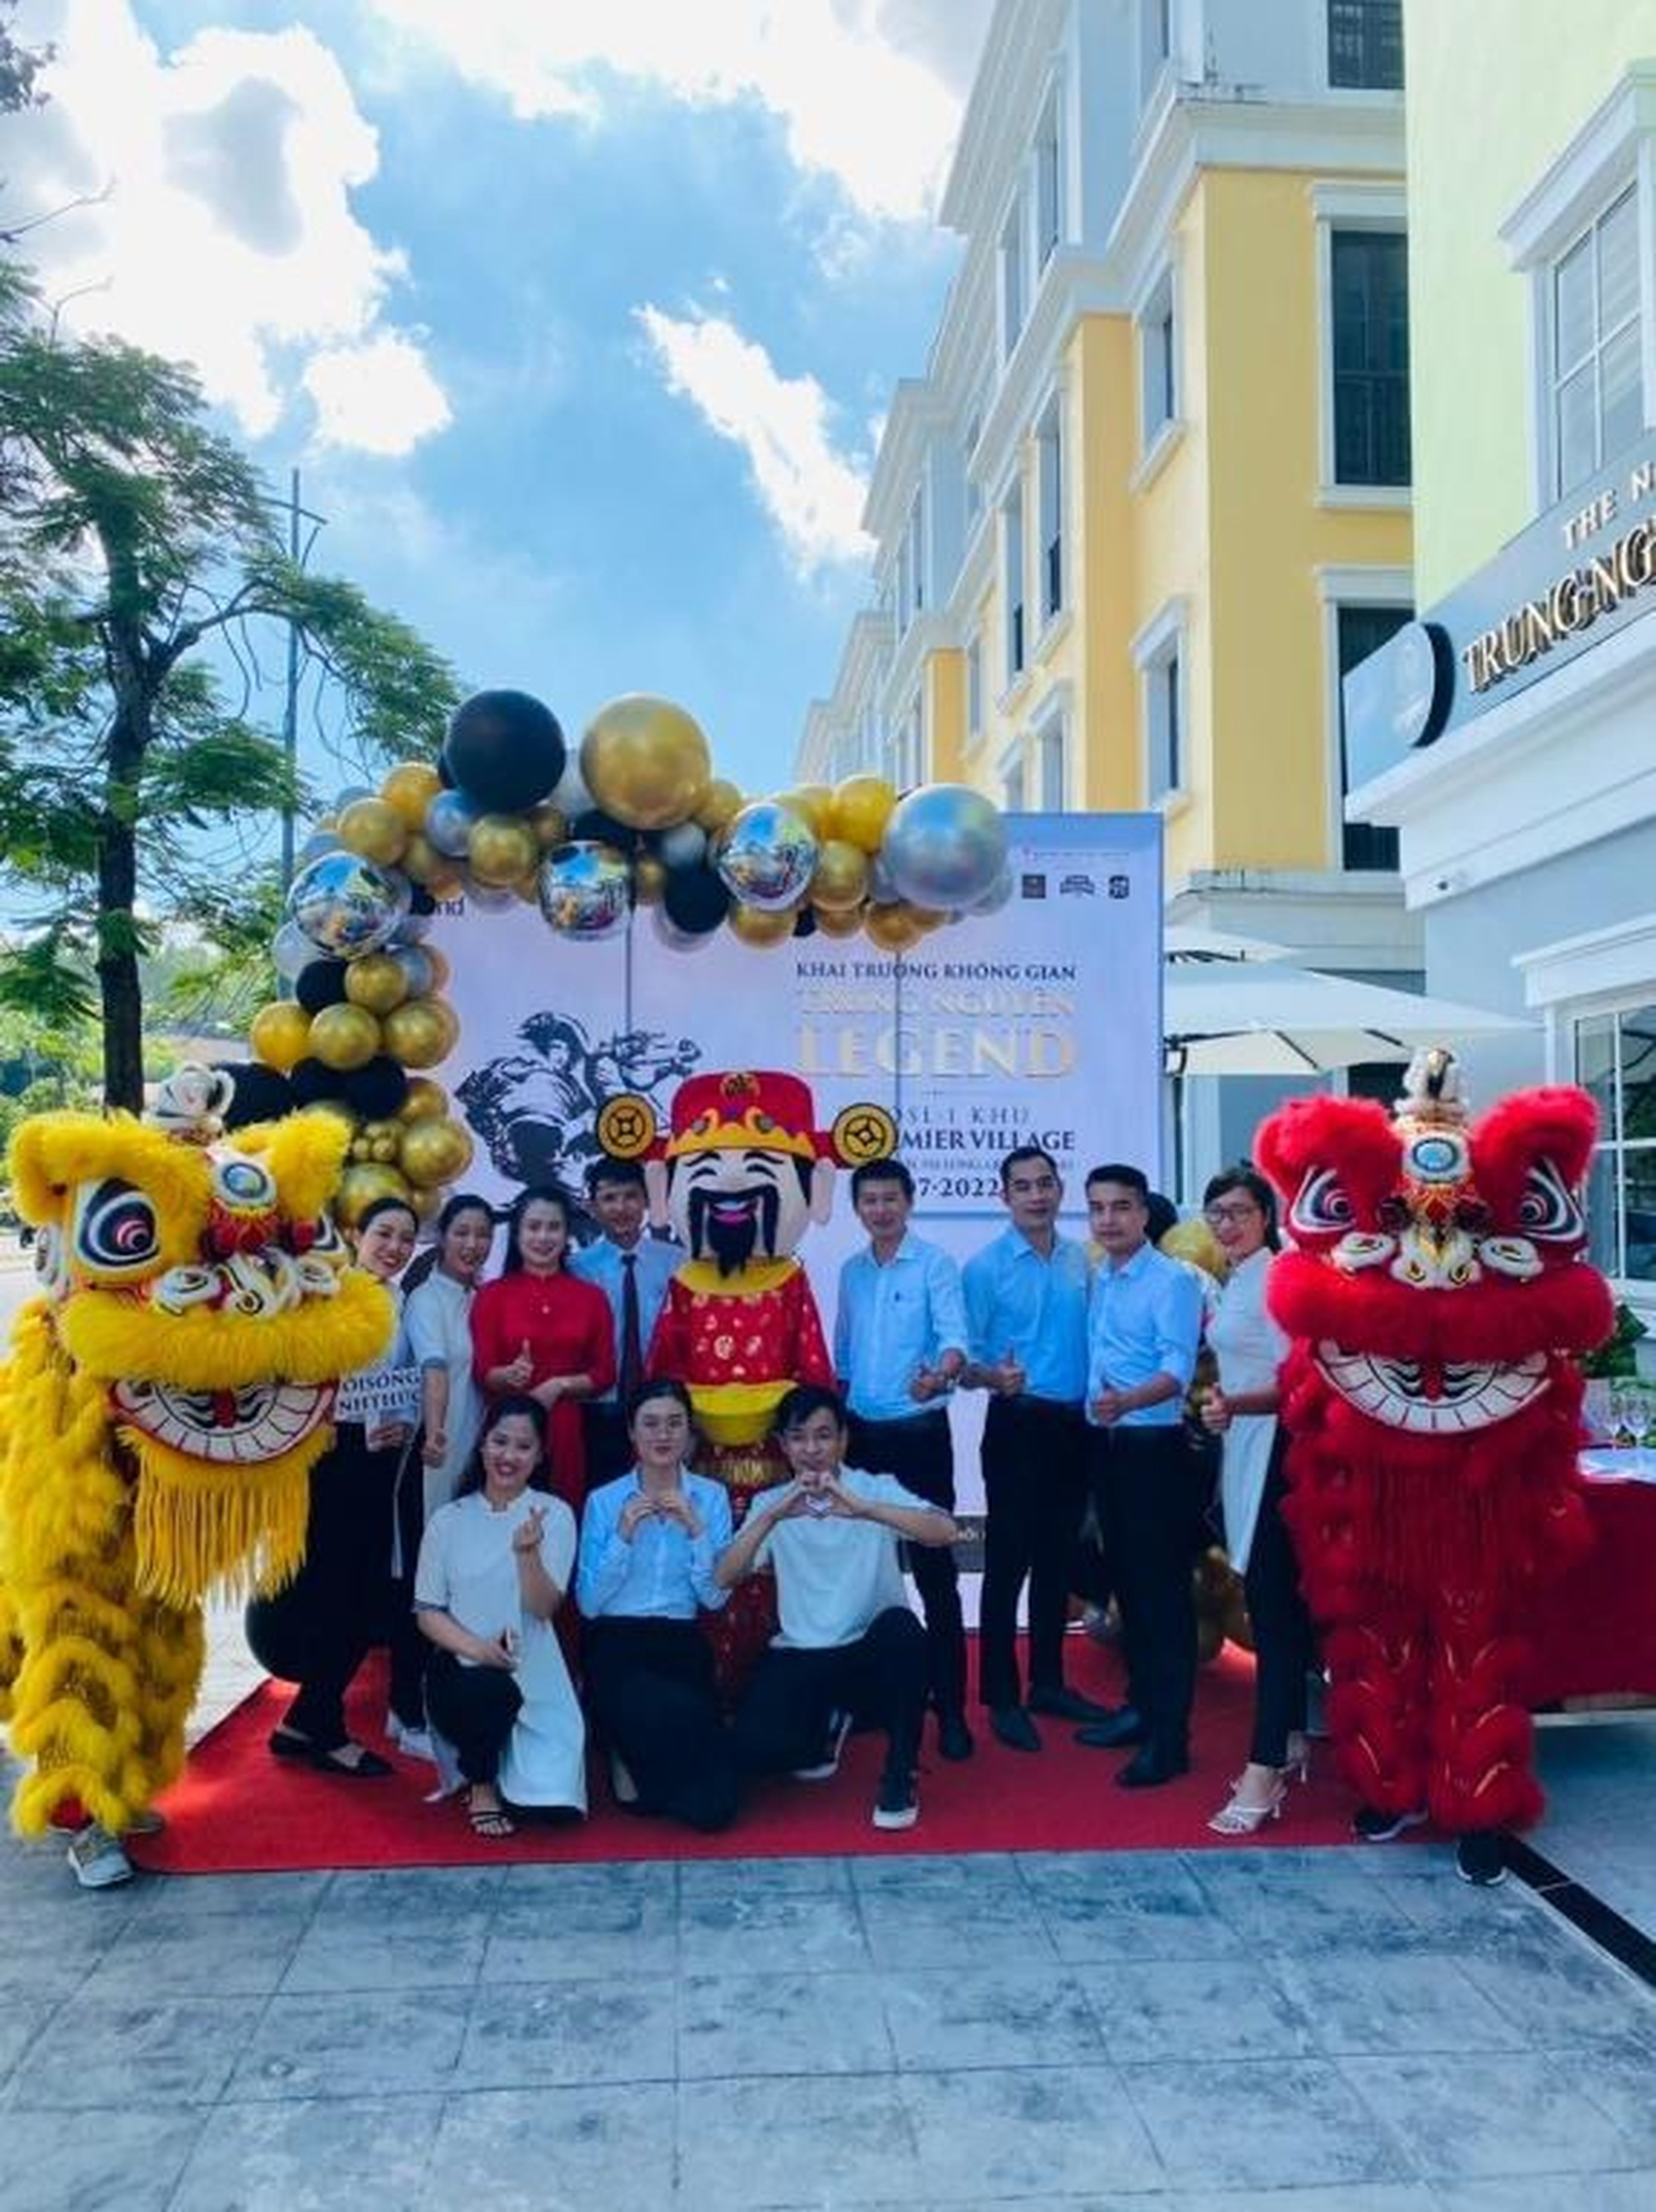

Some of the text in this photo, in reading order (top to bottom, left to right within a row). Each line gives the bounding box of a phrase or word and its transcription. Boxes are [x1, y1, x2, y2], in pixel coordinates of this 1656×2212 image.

[1562, 489, 1617, 551] THE
[1464, 514, 1656, 693] TRUNG NG
[797, 962, 846, 978] KHAI
[1024, 964, 1076, 980] GIAN
[798, 1026, 1077, 1078] LEGEND
[901, 1130, 1076, 1151] MIER VILLAGE
